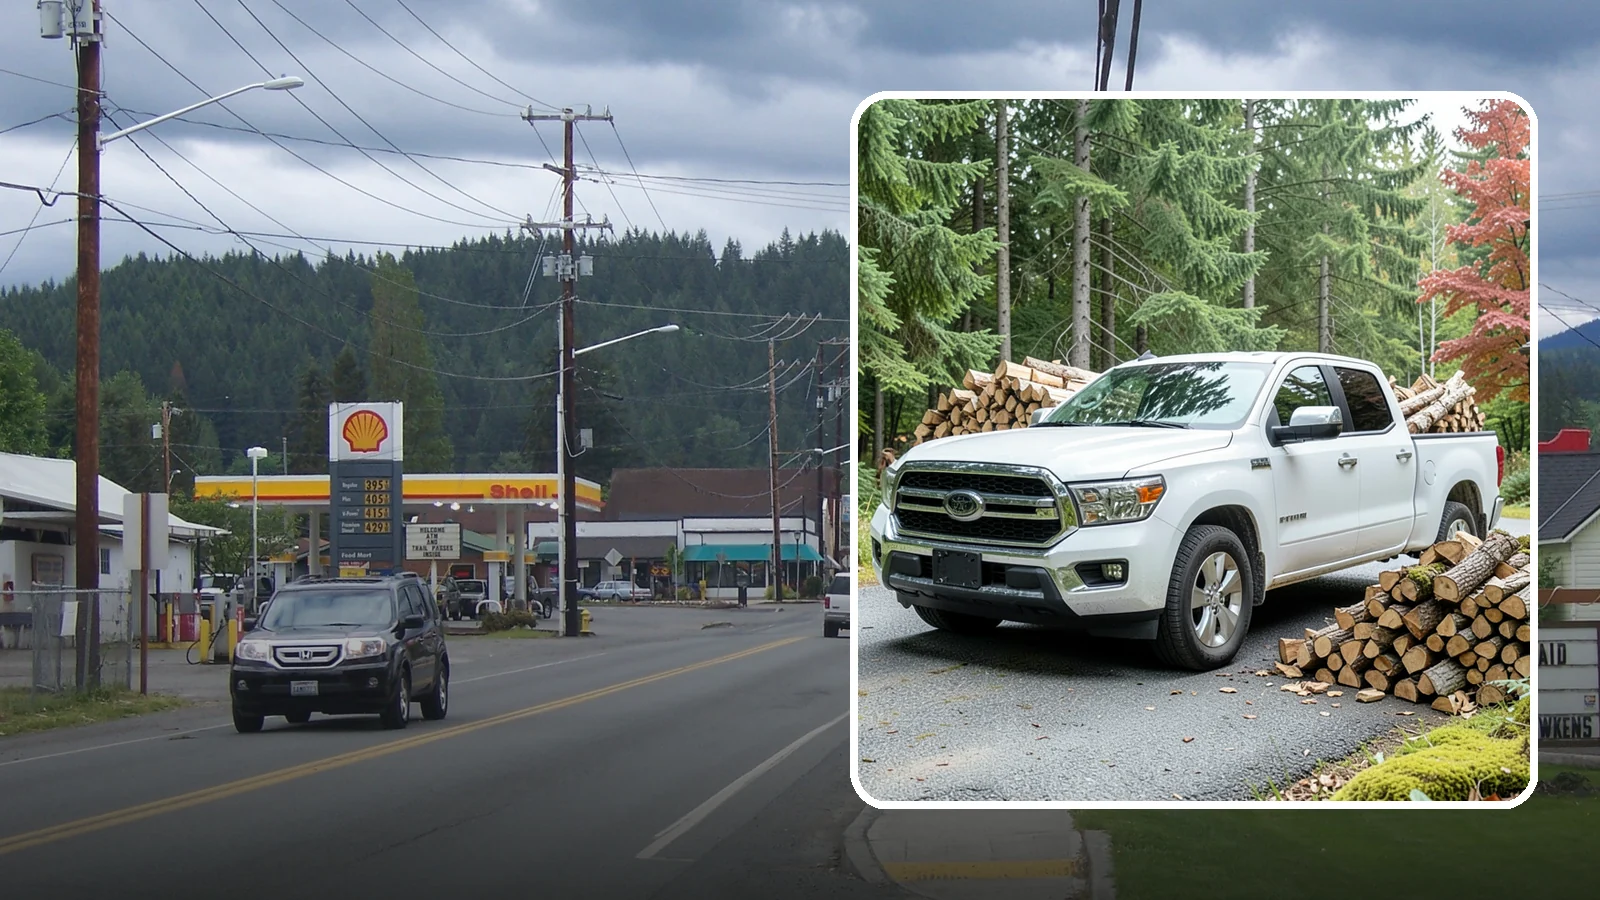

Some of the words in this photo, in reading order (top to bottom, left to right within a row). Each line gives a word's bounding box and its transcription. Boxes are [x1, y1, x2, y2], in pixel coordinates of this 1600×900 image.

[366, 480, 384, 490] 395
[490, 484, 547, 499] Shell
[366, 494, 384, 504] 405
[366, 508, 383, 518] 415
[366, 522, 384, 532] 429
[1539, 643, 1566, 665] AID
